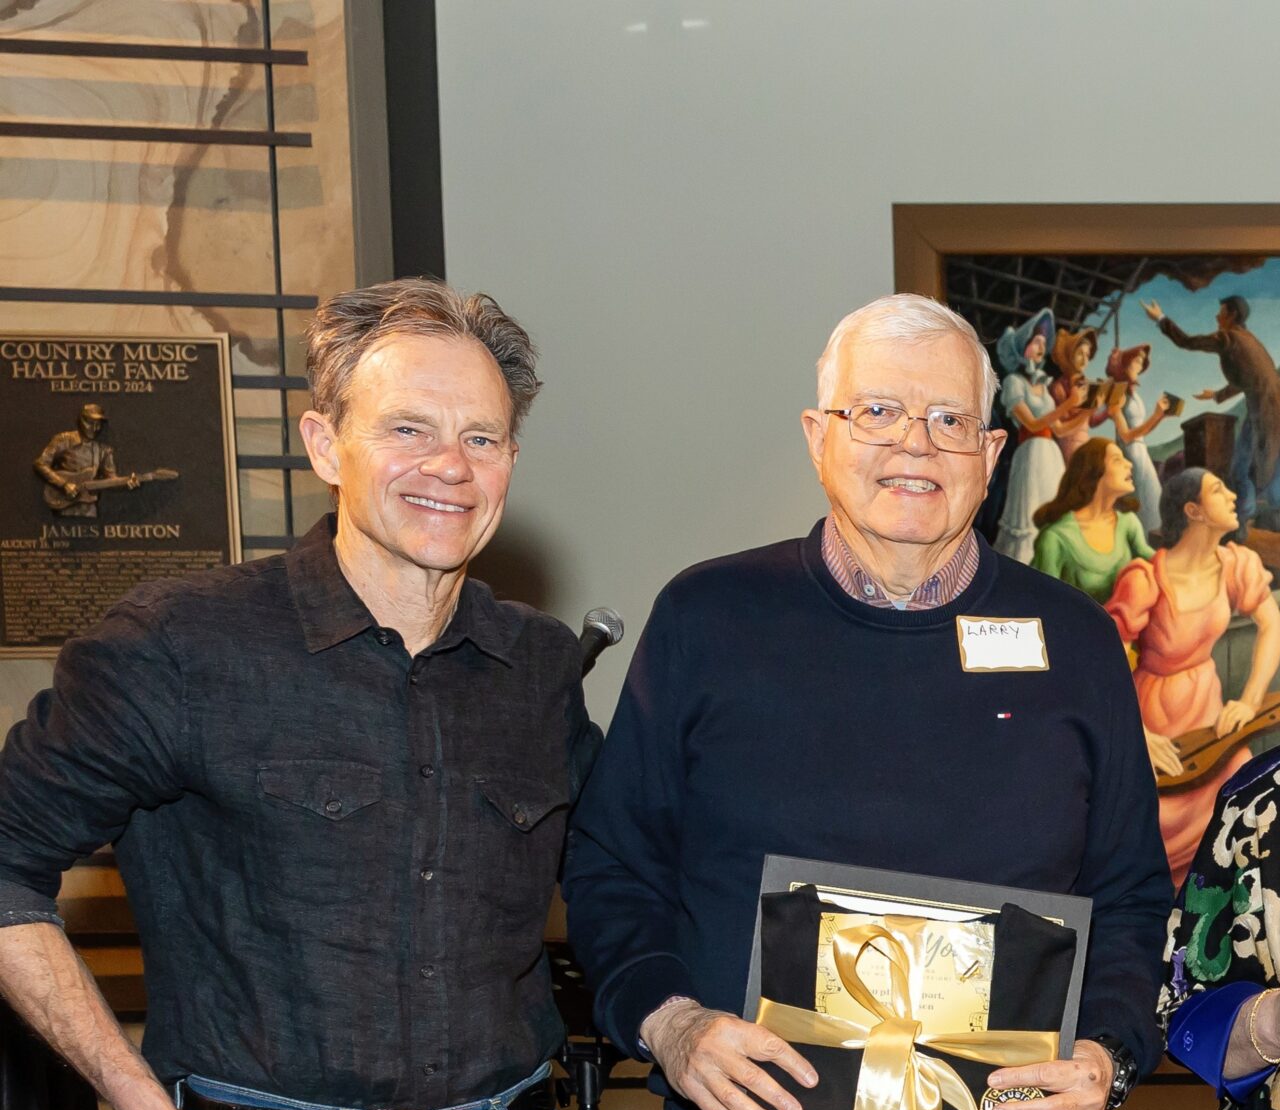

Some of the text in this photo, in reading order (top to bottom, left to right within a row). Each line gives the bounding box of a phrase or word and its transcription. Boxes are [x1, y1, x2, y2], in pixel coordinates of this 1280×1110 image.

[1, 342, 198, 362] COUNTRY MUSIC
[12, 362, 190, 380] HALL OF FAME
[51, 380, 152, 392] ELECTED 2024
[41, 525, 180, 539] JAMES BURTON
[1, 539, 36, 549] AUGUST
[967, 624, 1020, 639] LARRY
[926, 932, 954, 968] Yo
[999, 1090, 1031, 1102] MUSIC
